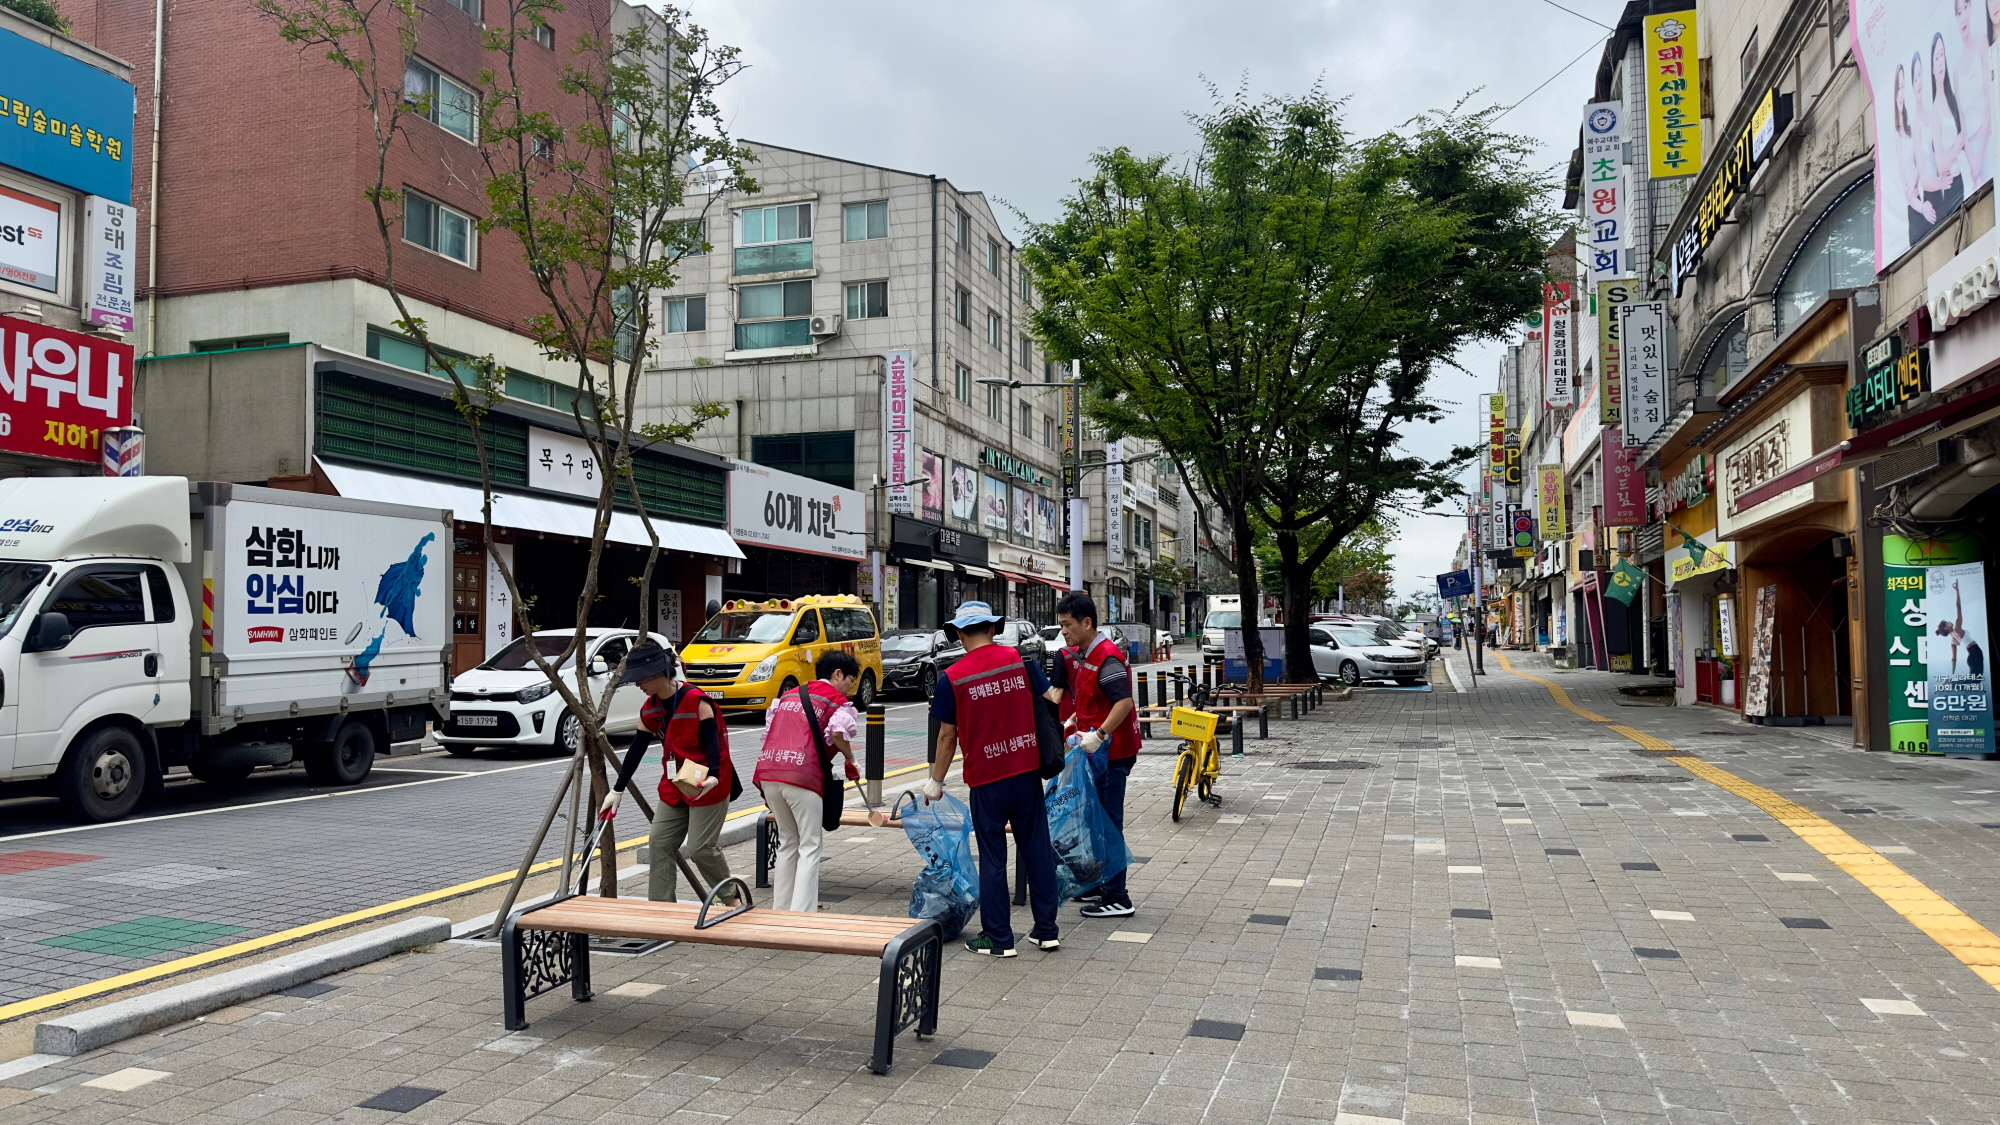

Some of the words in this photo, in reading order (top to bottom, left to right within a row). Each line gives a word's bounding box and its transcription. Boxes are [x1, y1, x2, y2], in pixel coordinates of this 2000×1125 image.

[1586, 135, 1620, 146] 예수교대한
[1587, 143, 1620, 154] 성결교회
[1591, 157, 1620, 276] 초원교회
[95, 293, 132, 314] 전문점
[1629, 346, 1638, 371] 그리고
[1641, 325, 1659, 378] 맛있는
[0, 327, 124, 419] 사우나
[891, 354, 906, 429] 스포라이크
[1845, 383, 1864, 430] 상록
[1865, 364, 1896, 414] 스터디
[1897, 348, 1922, 402] 센터
[1643, 389, 1660, 423] 술집
[0, 412, 12, 437] 6
[43, 419, 100, 451] 지하1
[1490, 395, 1504, 463] 킹노래방
[538, 447, 594, 480] 목구멍
[1505, 448, 1520, 483] PC
[0, 518, 54, 534] 안심이다
[764, 490, 802, 533] 60계
[807, 497, 836, 540] 치킨
[1110, 493, 1119, 553] 청담순대국
[1546, 507, 1558, 530] 서비스
[246, 526, 340, 570] 삼화니까
[246, 573, 339, 615] 안심이다
[1887, 576, 1923, 591] 최적의
[661, 593, 672, 621] 응당
[1901, 598, 1927, 627] 상
[248, 629, 279, 639] SAMHWA
[288, 627, 338, 641] 삼화페인트
[1720, 608, 1731, 653] 맥주&소주
[969, 680, 1001, 701] 명예환경
[1002, 675, 1026, 693] 감시원
[1954, 682, 1984, 691] (1개월)
[1933, 694, 1988, 711] 6만원
[476, 717, 494, 725] 1799
[775, 749, 806, 766] 상록구청
[983, 740, 1009, 760] 안산시
[1009, 732, 1037, 752] 상록구청
